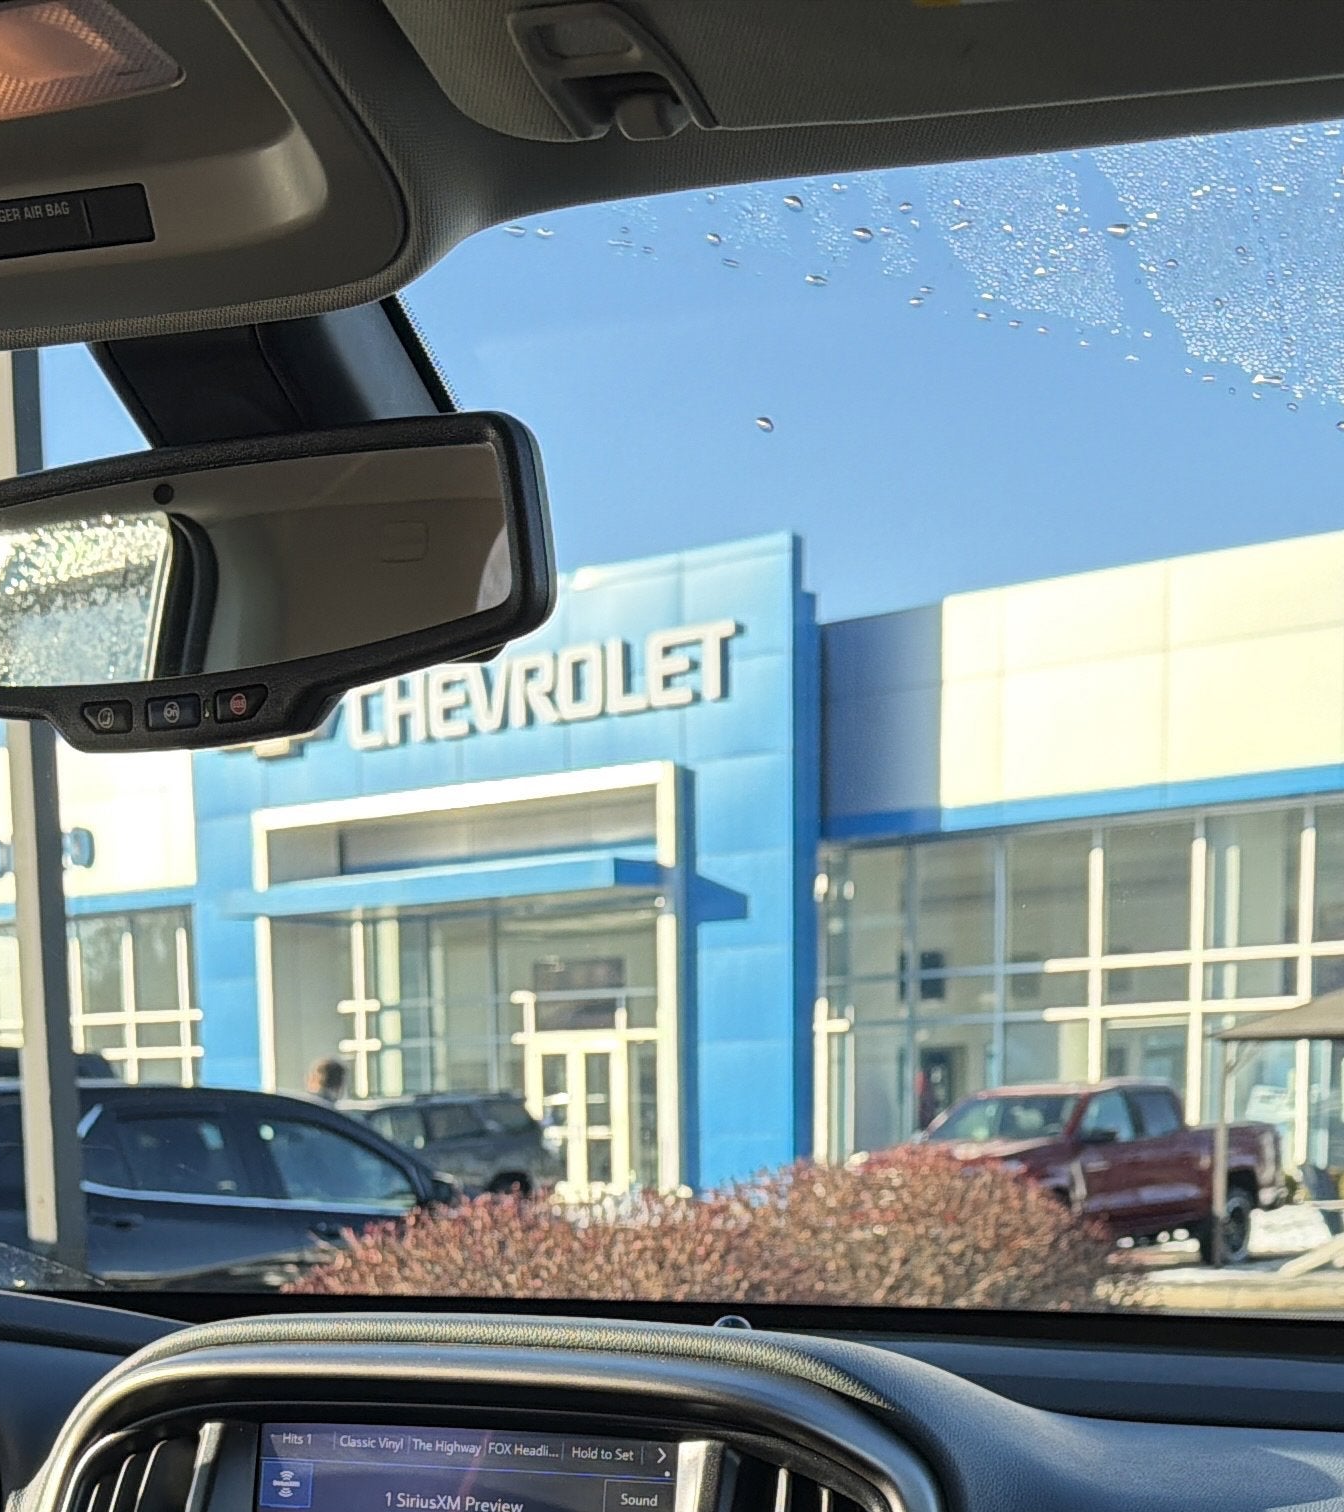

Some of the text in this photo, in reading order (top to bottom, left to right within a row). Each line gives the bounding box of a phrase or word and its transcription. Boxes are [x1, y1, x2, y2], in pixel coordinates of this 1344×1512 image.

[24, 205, 44, 220] AIR
[45, 201, 70, 217] BAG
[346, 618, 741, 752] CHEVROLET
[282, 1432, 304, 1445] Hits
[339, 1434, 404, 1451] Classic Vinyl
[411, 1438, 482, 1457] The Highway
[488, 1442, 559, 1458] FOX Headli...
[571, 1446, 635, 1462] Hold to Set
[385, 1491, 392, 1507] 1
[395, 1492, 461, 1511] SiriusXM
[620, 1493, 658, 1508] Sound
